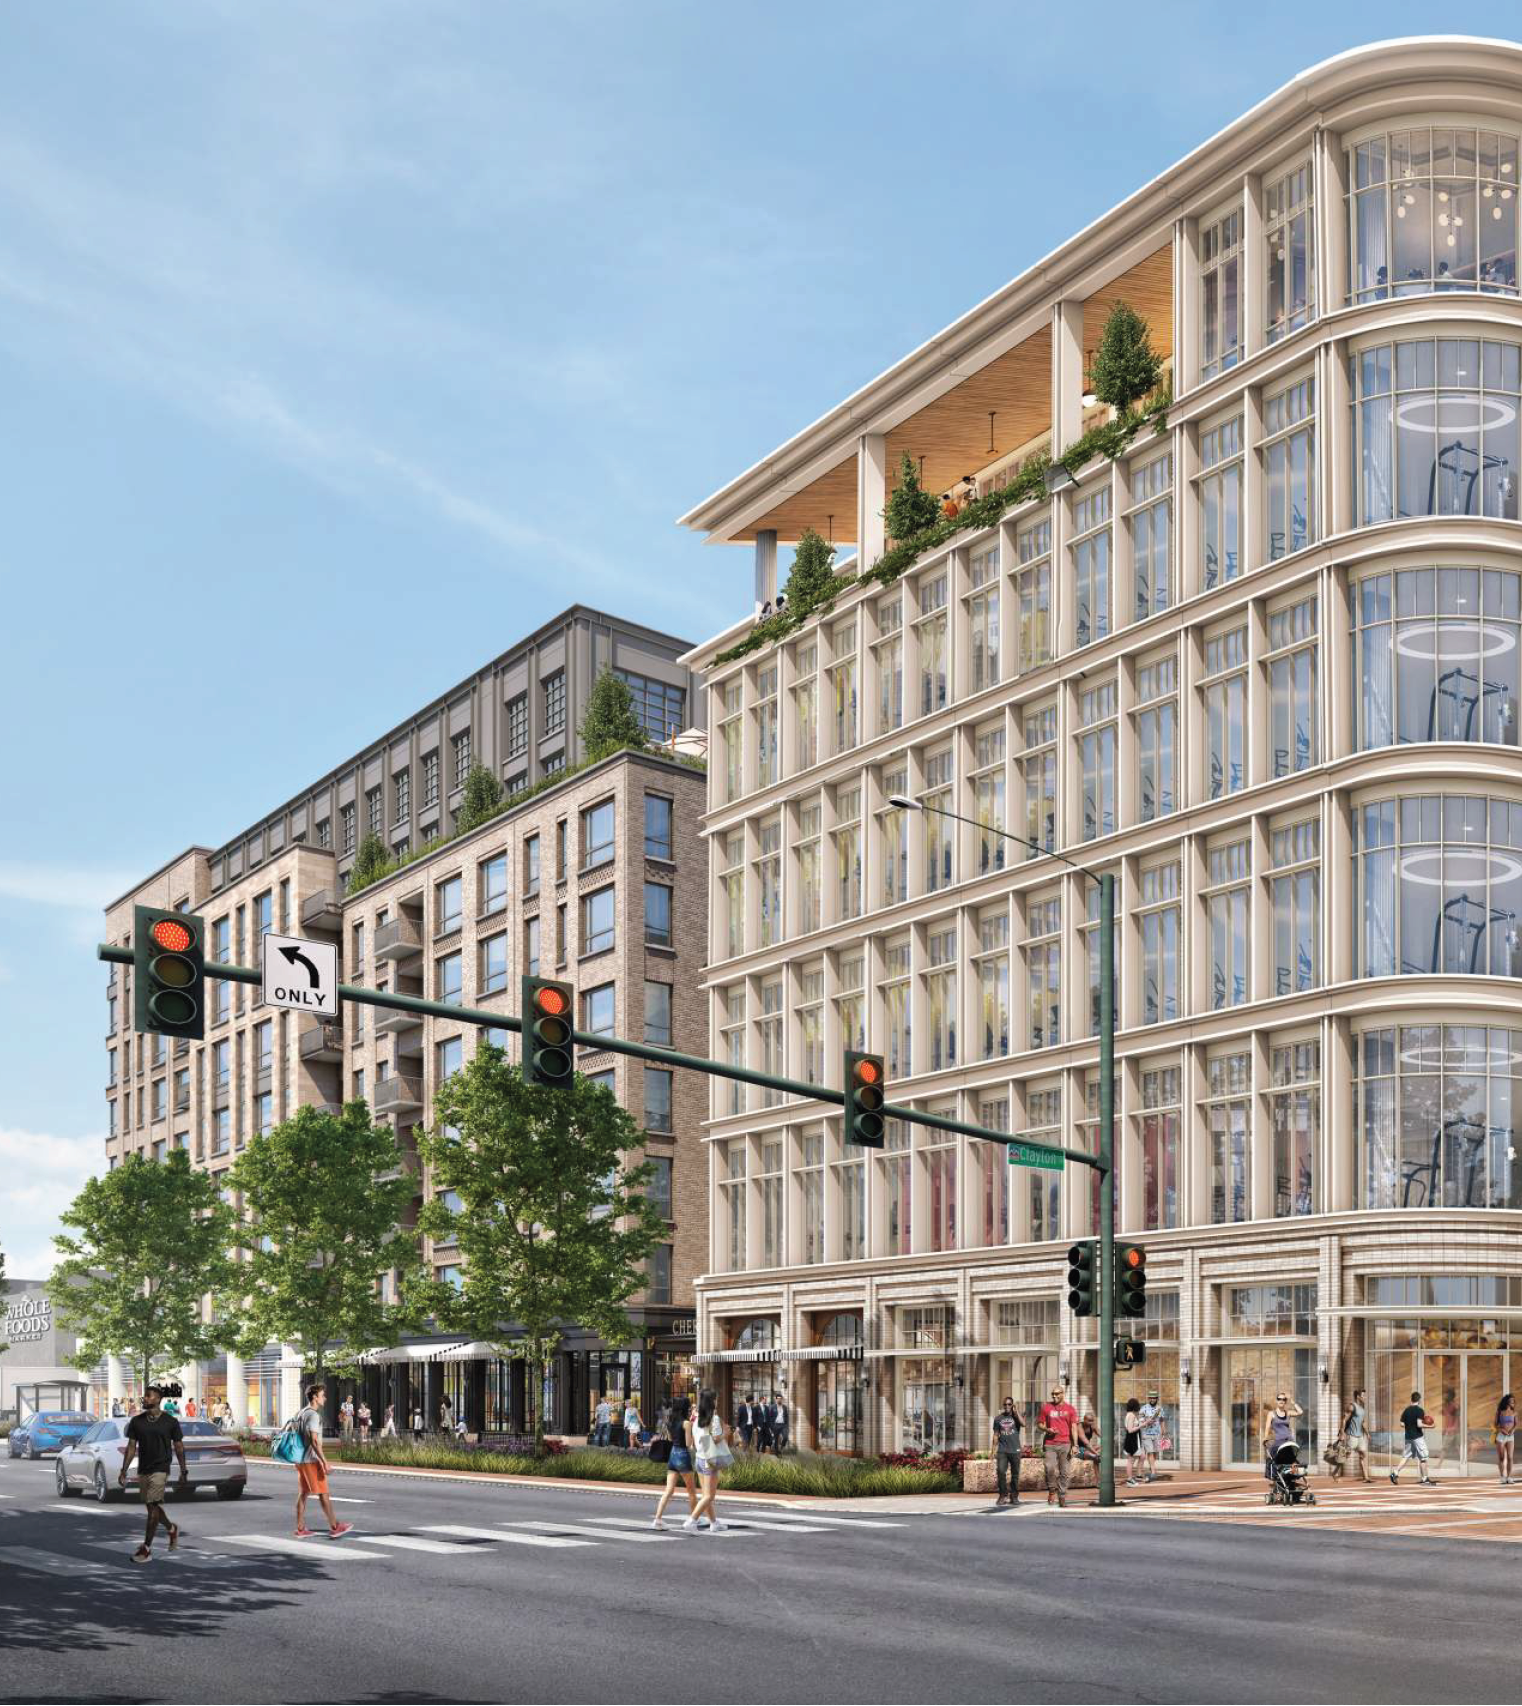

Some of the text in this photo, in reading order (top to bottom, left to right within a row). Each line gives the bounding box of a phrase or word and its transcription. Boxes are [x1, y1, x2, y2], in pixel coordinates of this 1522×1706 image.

[275, 987, 326, 1006] ONLY
[1020, 1147, 1056, 1166] Clayton
[7, 1299, 51, 1320] WHOLE
[5, 1316, 50, 1335] FOODS
